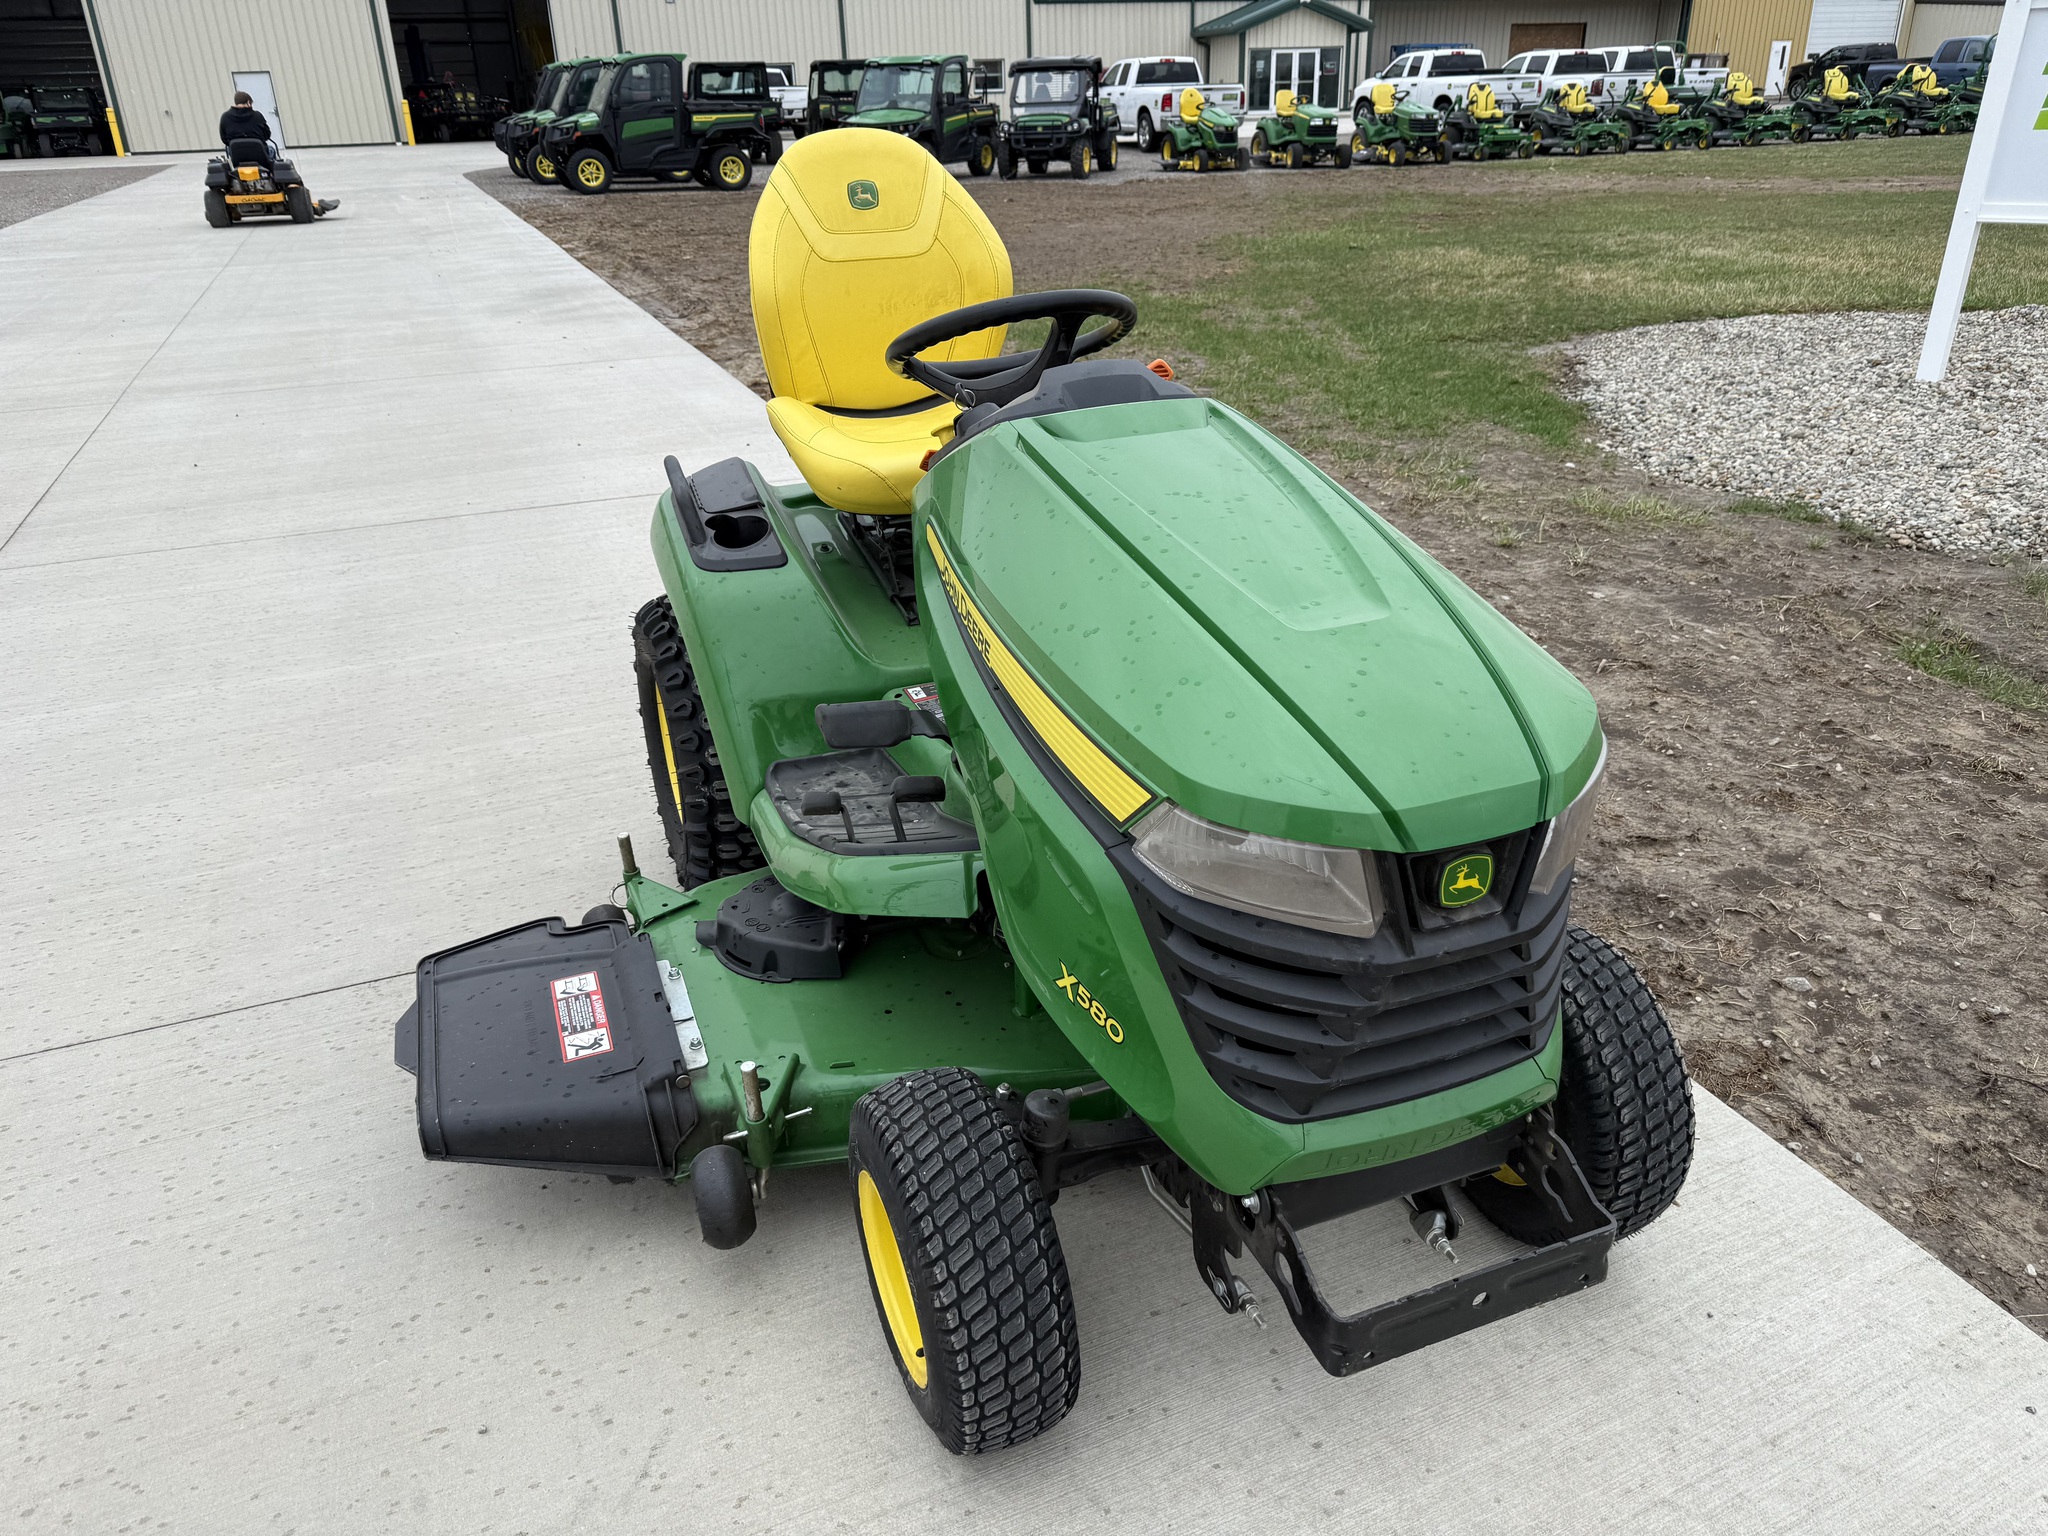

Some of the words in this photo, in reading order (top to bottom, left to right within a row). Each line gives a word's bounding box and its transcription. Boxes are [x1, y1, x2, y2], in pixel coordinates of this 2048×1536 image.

[940, 557, 961, 613] JOHN
[961, 592, 991, 666] DEERE
[593, 1000, 606, 1024] DANGER
[1053, 958, 1125, 1044] X580
